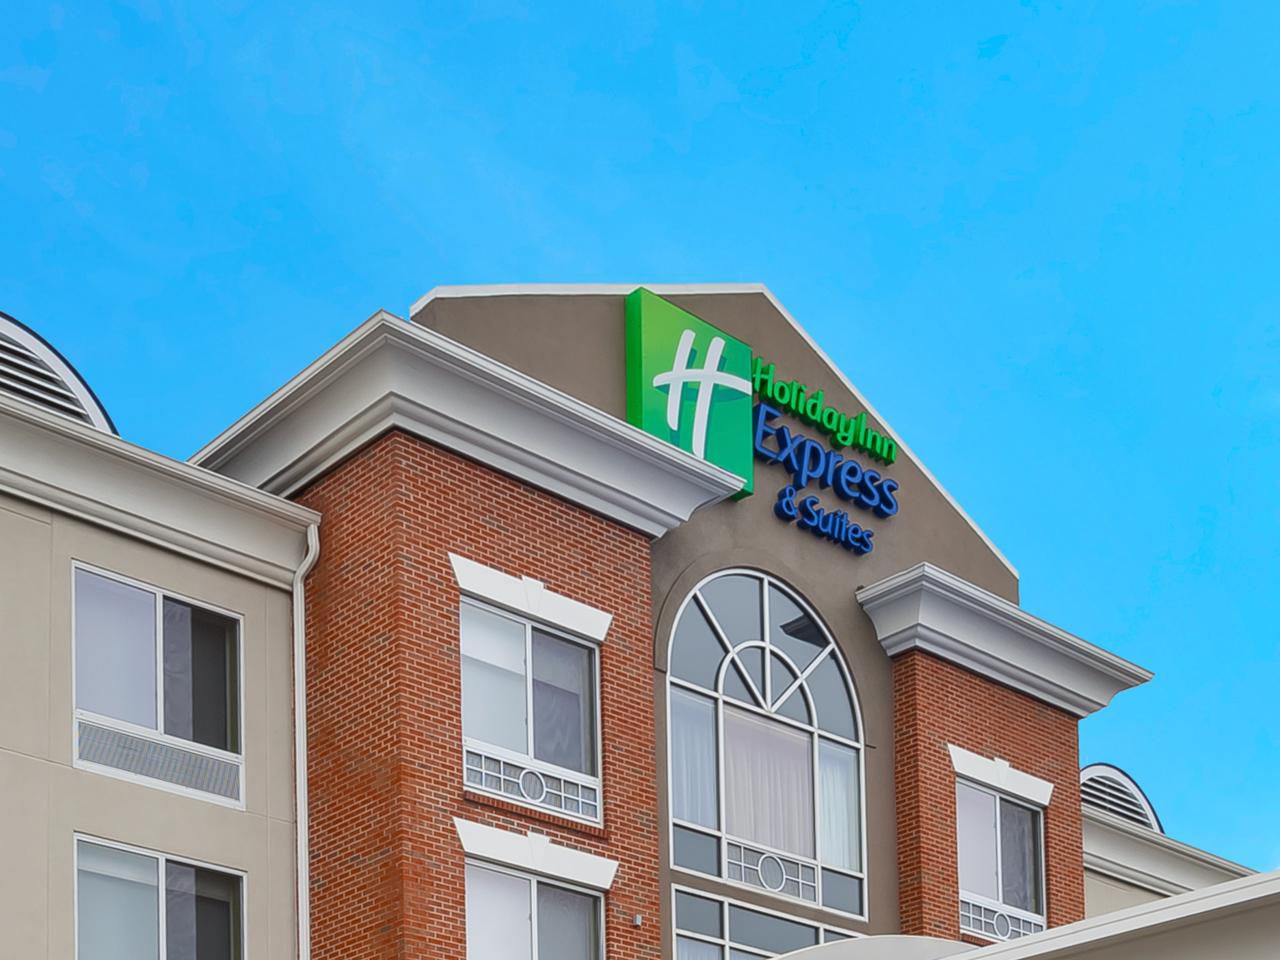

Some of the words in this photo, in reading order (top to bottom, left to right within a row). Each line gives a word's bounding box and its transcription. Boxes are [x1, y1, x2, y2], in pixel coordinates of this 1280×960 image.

[754, 403, 899, 518] Express
[775, 484, 799, 521] &
[800, 496, 874, 555] Suites
